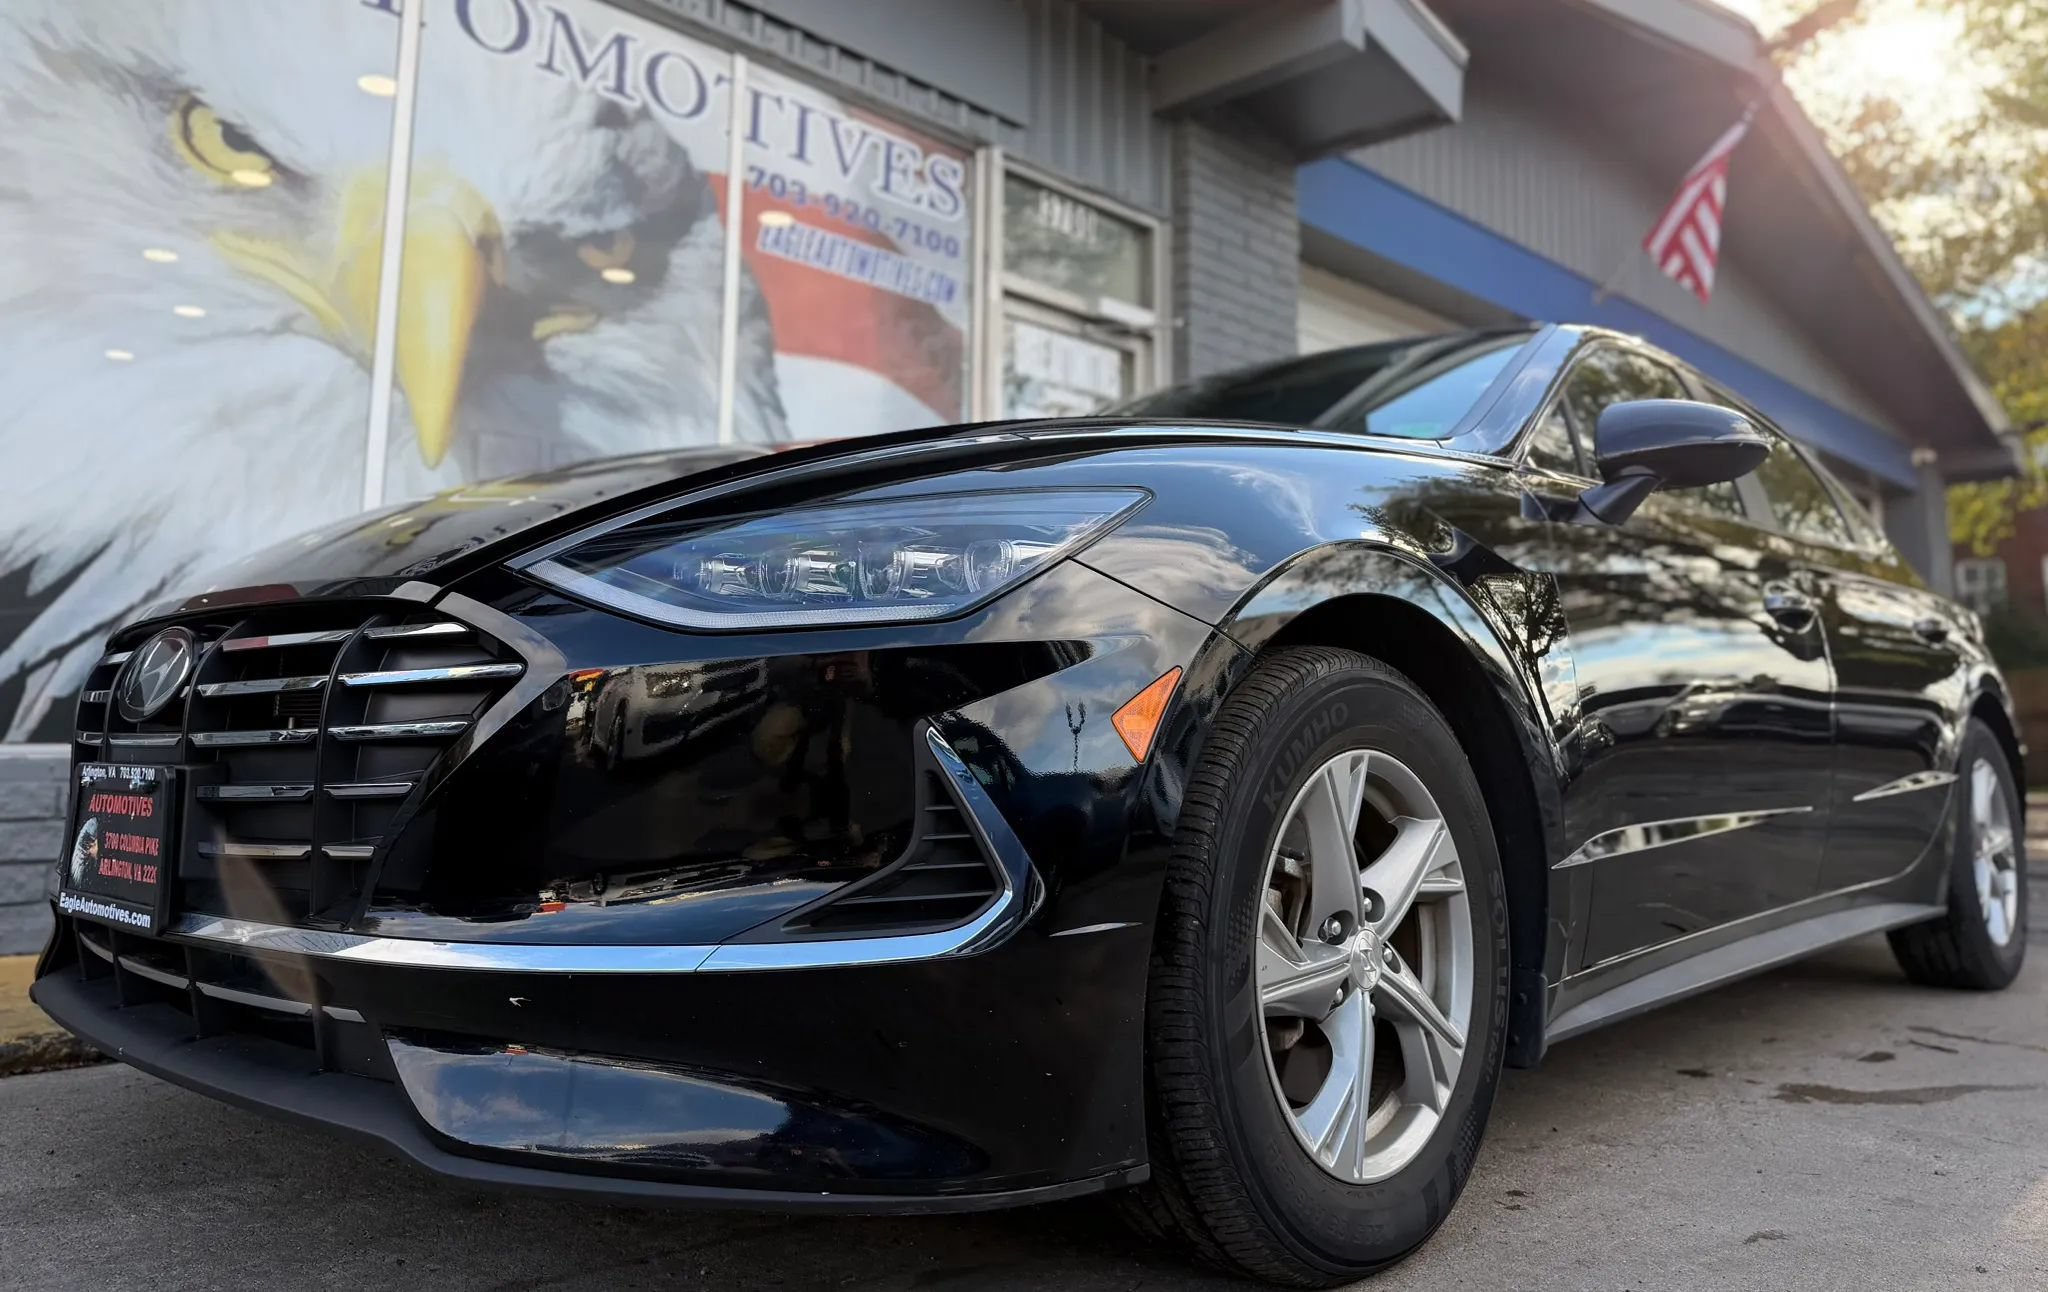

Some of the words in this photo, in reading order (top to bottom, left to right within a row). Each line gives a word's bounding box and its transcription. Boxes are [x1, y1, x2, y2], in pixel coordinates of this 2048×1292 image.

[748, 166, 961, 259] 703-920-7100
[108, 766, 116, 779] VA
[1263, 702, 1349, 815] KUMHO
[89, 795, 152, 817] AUTOMOTIVES
[133, 863, 142, 881] VA
[60, 893, 150, 928] EagleAutomotives.com
[1489, 870, 1507, 1028] SOLUS
